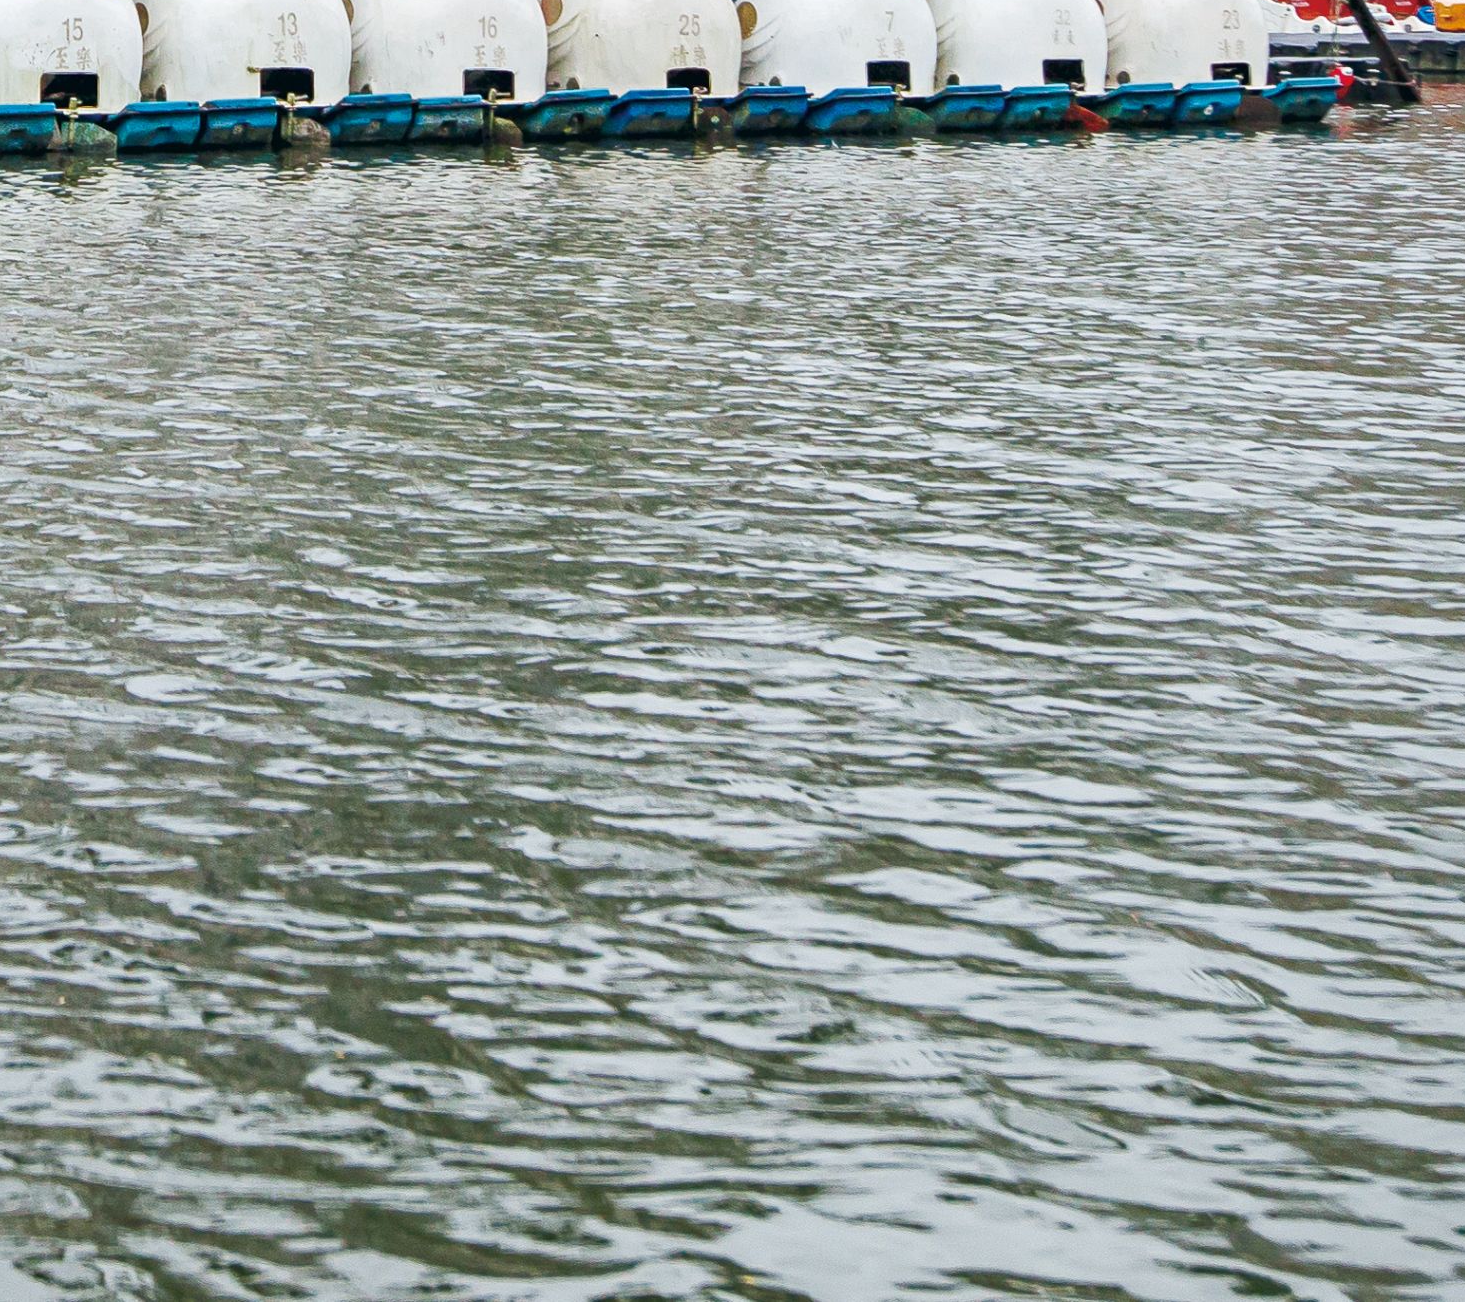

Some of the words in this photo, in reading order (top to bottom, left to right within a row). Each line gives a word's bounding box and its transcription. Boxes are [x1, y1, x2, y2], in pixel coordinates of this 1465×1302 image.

[62, 17, 84, 42] 15
[278, 12, 298, 36] 13
[478, 16, 498, 38] 16
[678, 14, 700, 36] 25
[885, 11, 894, 32] 7
